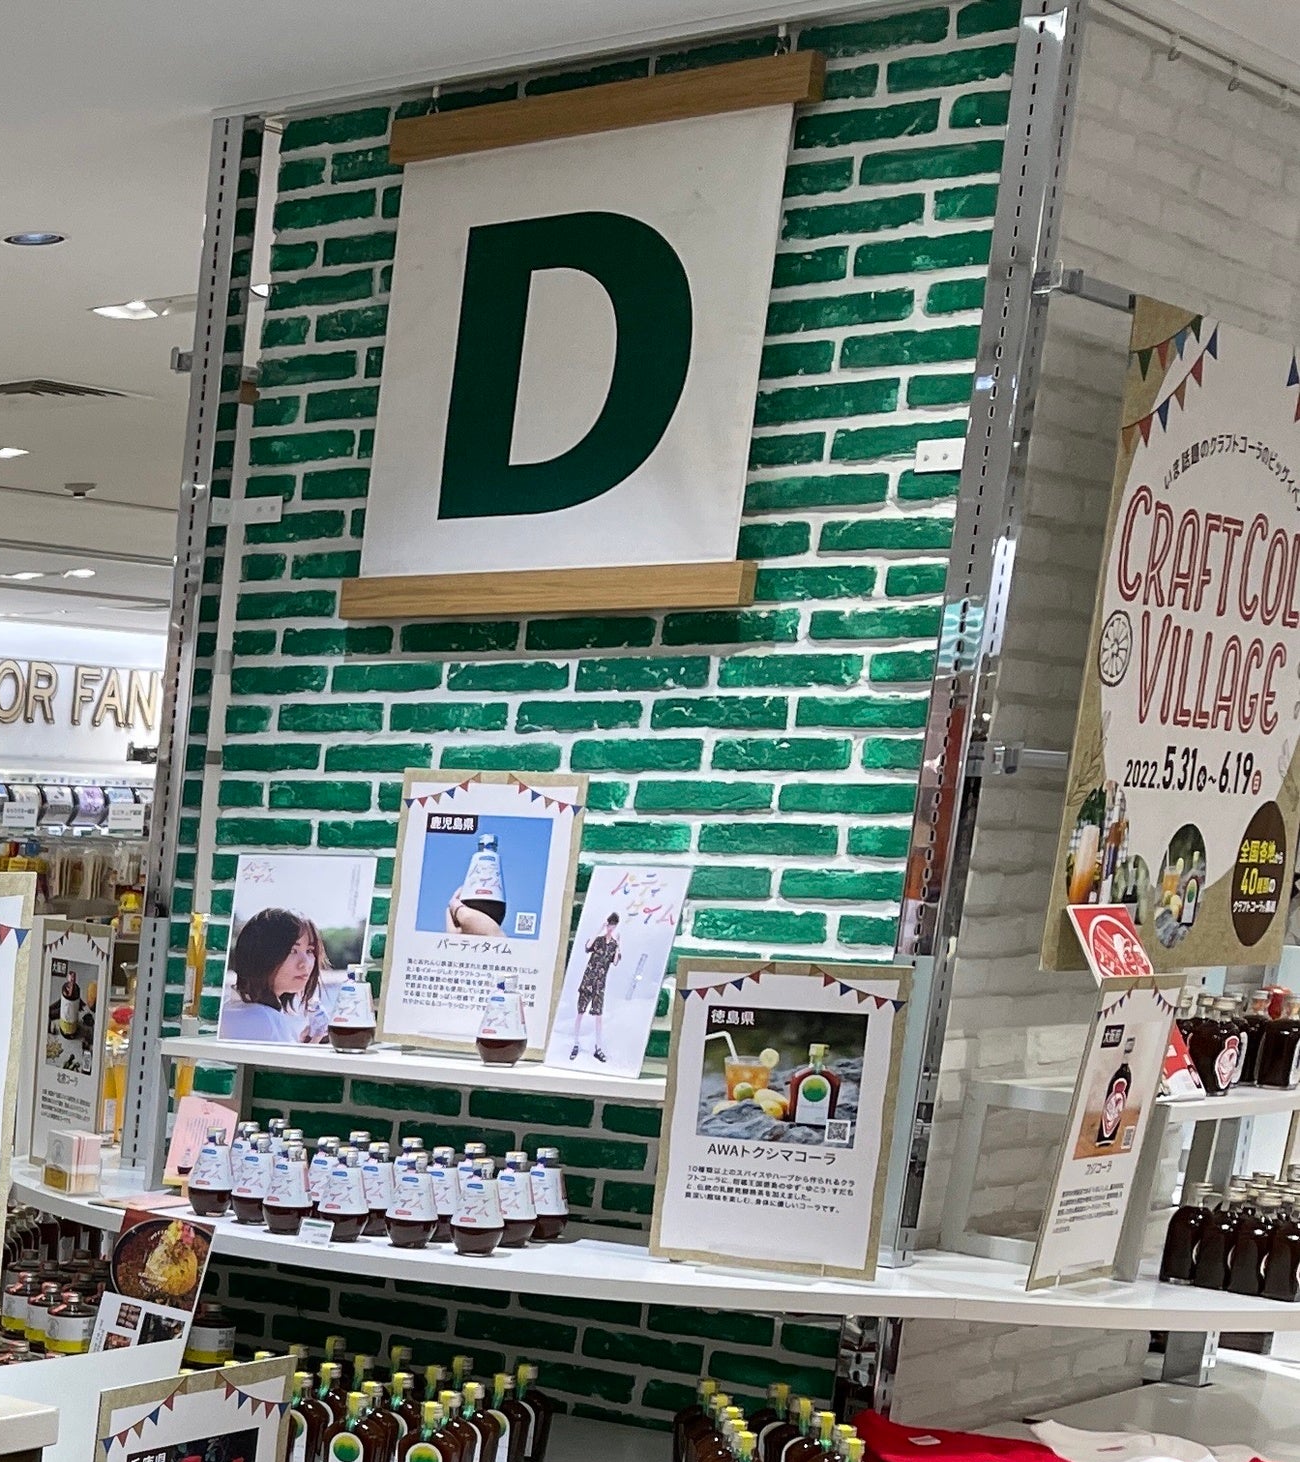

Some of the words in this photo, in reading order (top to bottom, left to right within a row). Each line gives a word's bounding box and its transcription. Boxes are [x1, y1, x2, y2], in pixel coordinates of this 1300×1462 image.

[437, 211, 693, 521] D
[1164, 434, 1300, 511] いま話題のクラフトコーラのビッグイベ
[1118, 485, 1244, 617] CRAFT
[1239, 513, 1300, 630] COL
[71, 665, 159, 730] FAN
[1137, 610, 1287, 737] VILLAGE
[429, 815, 475, 832] 鹿児島県
[436, 938, 512, 955] パーティタイム
[711, 1008, 755, 1026] 徳島県
[707, 1143, 837, 1166] AWAトクシマコーラ
